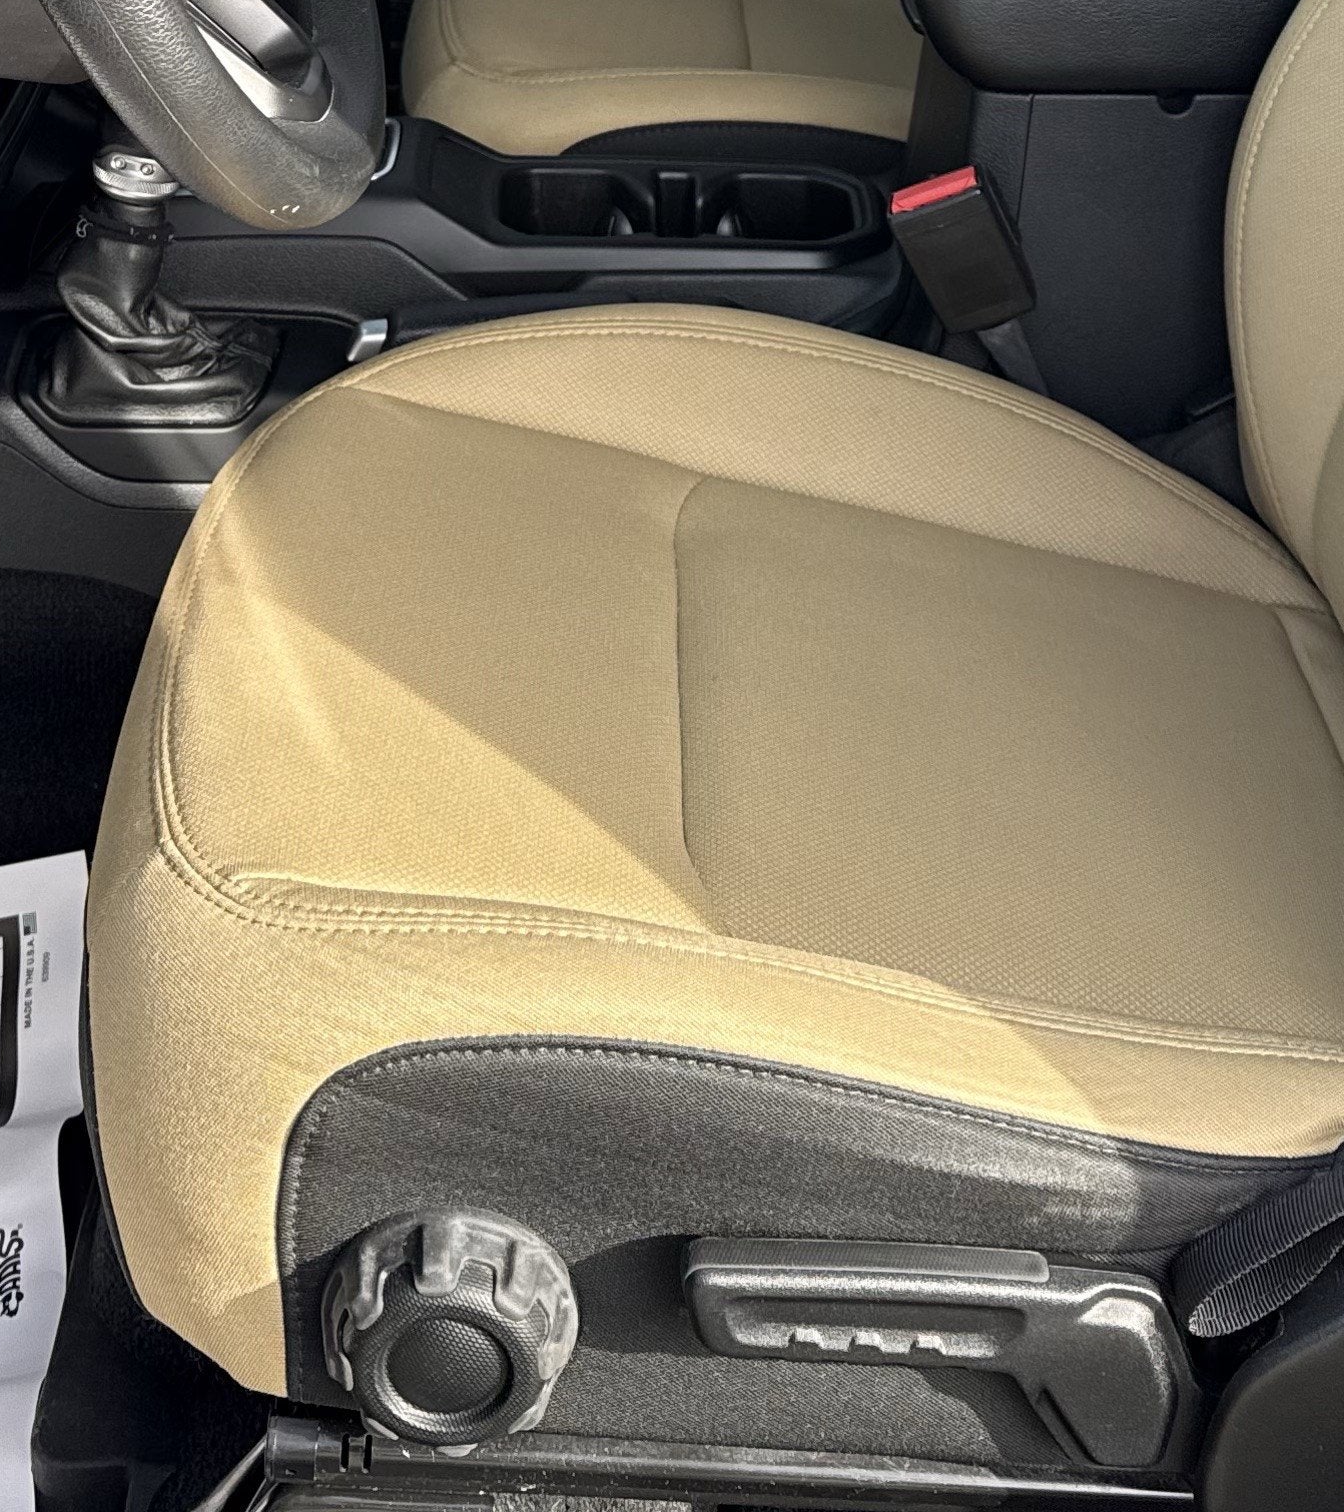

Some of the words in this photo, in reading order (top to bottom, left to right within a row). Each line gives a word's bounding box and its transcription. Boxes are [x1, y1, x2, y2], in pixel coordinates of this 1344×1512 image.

[25, 966, 34, 985] THE
[24, 986, 33, 997] IN
[24, 999, 33, 1028] MADE
